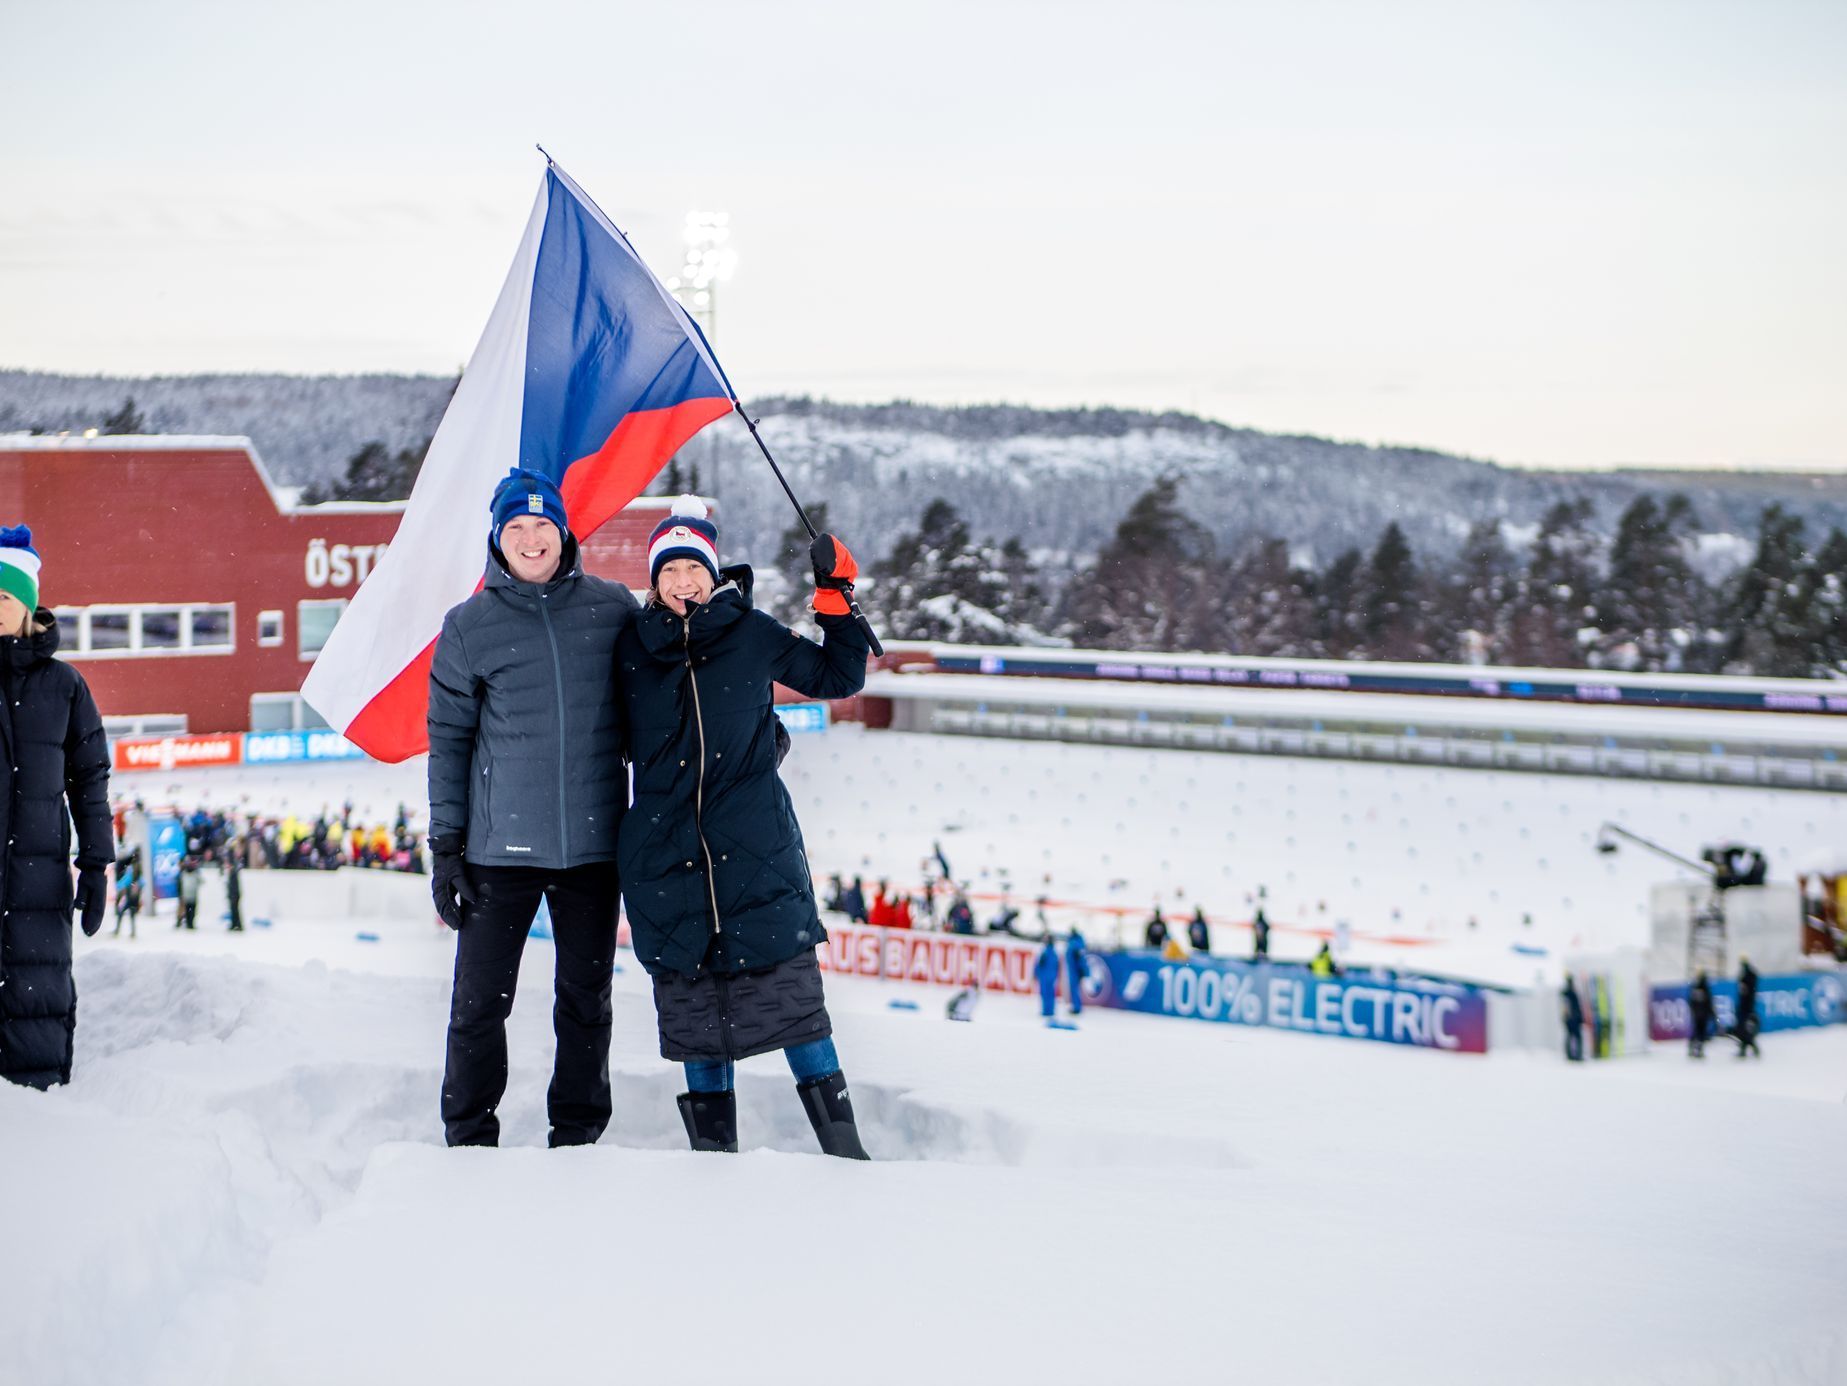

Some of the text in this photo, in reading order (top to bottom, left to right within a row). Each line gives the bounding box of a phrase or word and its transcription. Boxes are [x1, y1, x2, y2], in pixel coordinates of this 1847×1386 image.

[884, 936, 1033, 993] BAUHAU
[1158, 965, 1461, 1050] 100% ELECTRIC
